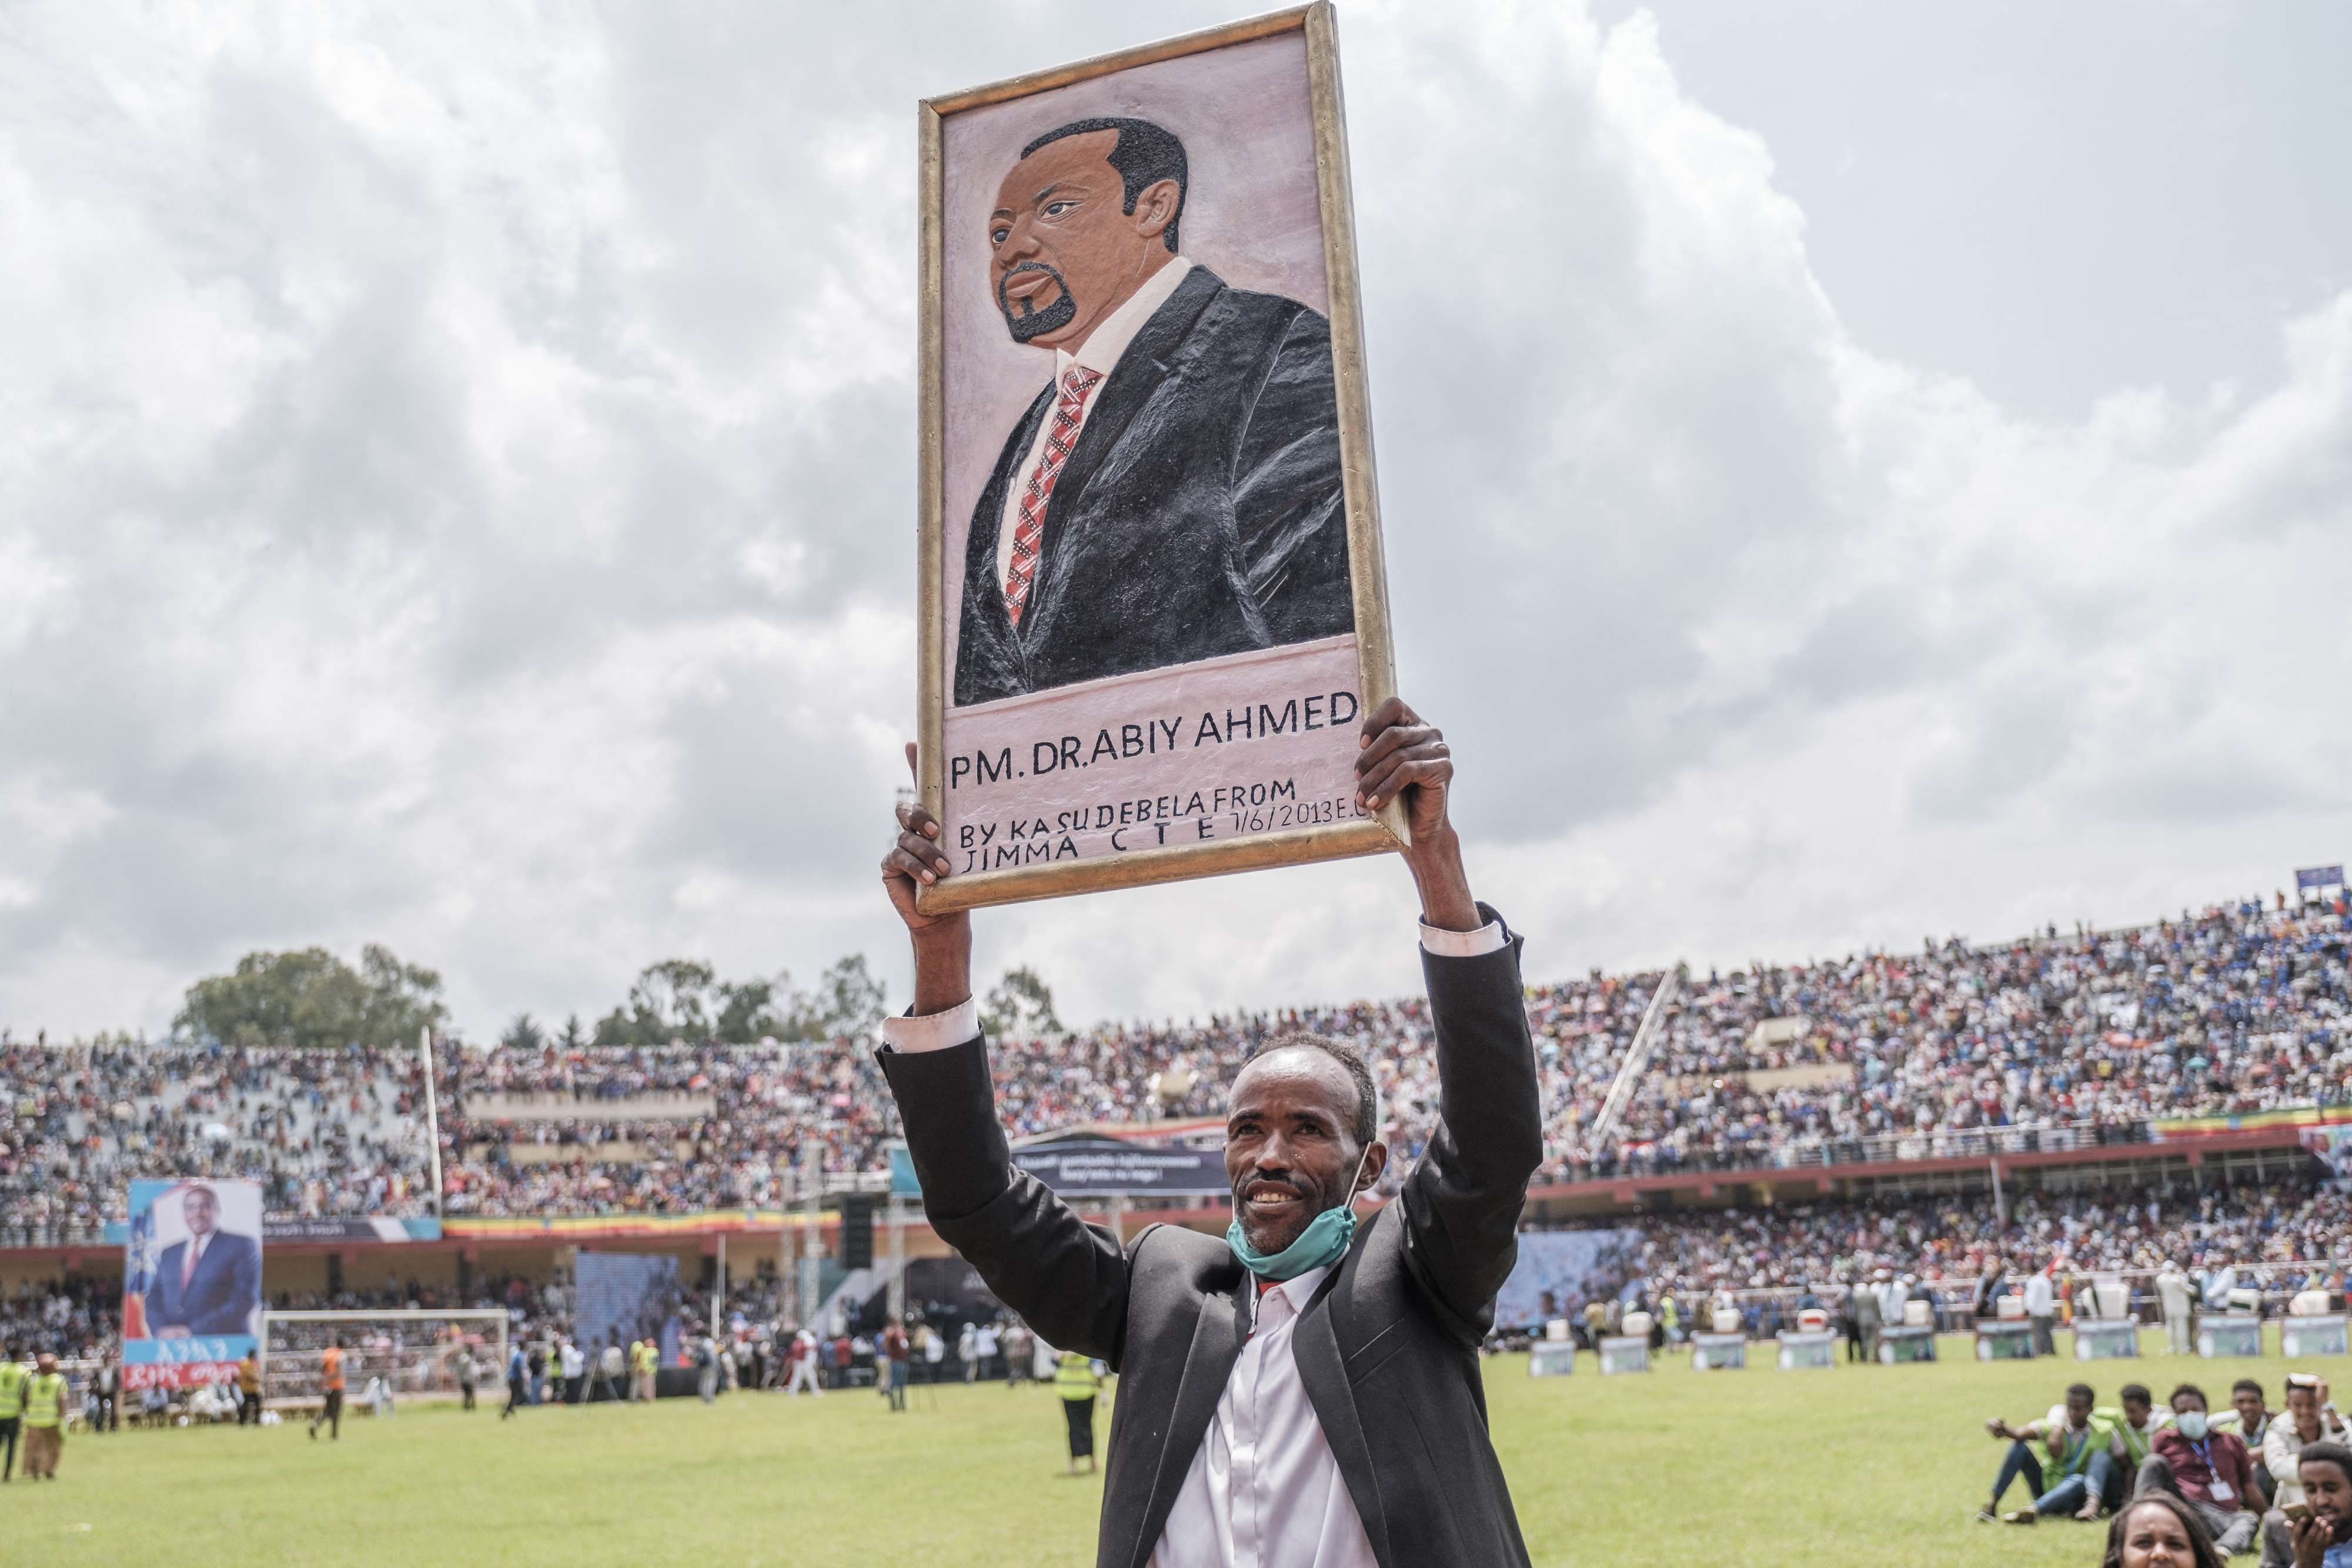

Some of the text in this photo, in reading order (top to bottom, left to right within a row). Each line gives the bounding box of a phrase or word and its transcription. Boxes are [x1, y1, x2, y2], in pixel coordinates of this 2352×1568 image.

[951, 747, 1025, 790] PM.
[1194, 691, 1358, 747] AHMED
[960, 823, 997, 849] BY
[1214, 777, 1296, 813] FROM
[960, 835, 1078, 874] JIMMA
